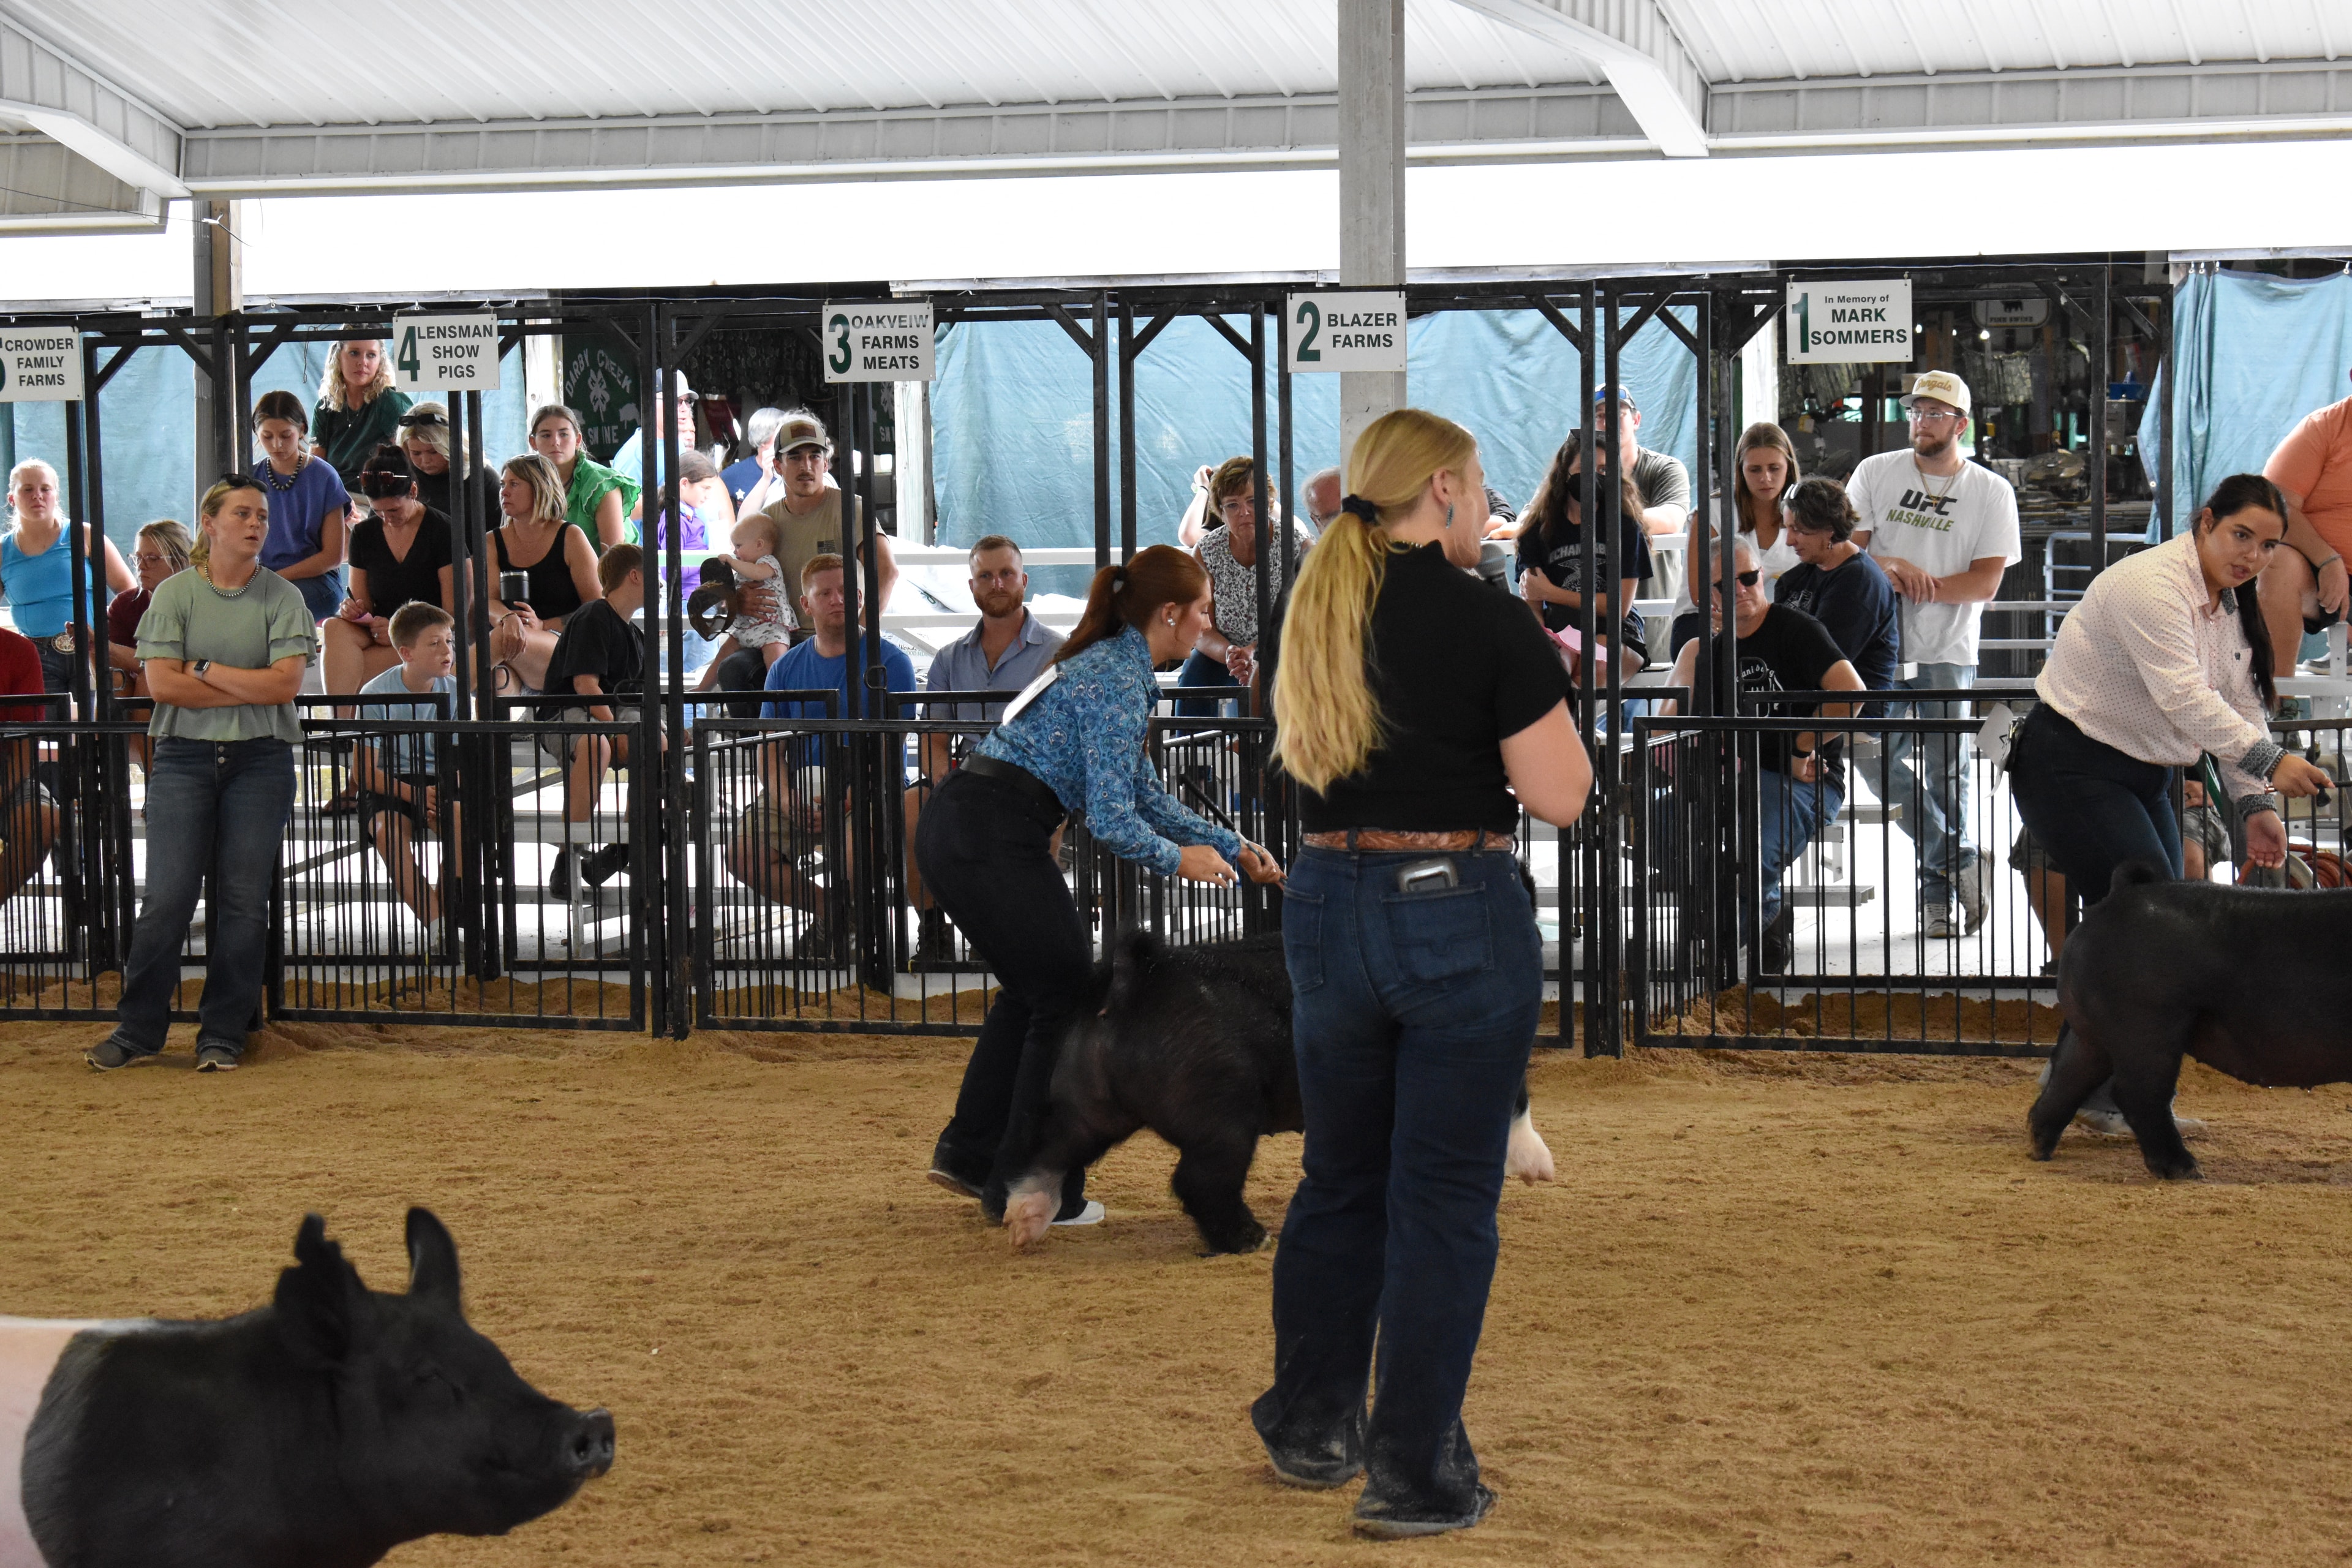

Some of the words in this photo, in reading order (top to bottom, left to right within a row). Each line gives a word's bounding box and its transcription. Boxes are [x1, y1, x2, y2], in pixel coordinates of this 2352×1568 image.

[1838, 295, 1876, 304] Memory
[851, 314, 929, 329] OAKVEIW
[1328, 313, 1397, 326] BLAZER
[1792, 293, 1809, 353] 1
[1831, 308, 1887, 323] MARK
[418, 324, 493, 339] LENSMAN
[1296, 301, 1321, 361] 2
[1811, 329, 1907, 345] SOMMERS
[5, 338, 74, 352] CROWDER
[828, 314, 852, 374] 3
[862, 335, 919, 349] FARMS
[1333, 334, 1393, 348] FARMS
[398, 326, 420, 382] 4
[432, 345, 480, 359] SHOW
[17, 356, 64, 369] FAMILY
[863, 355, 919, 369] MEATS
[439, 364, 475, 378] PIGS
[565, 348, 590, 398] DARBY
[597, 349, 632, 394] CREEK
[19, 374, 65, 386] FARMS
[587, 425, 619, 445] SWINE
[1899, 489, 1958, 516] UFC
[1886, 509, 1954, 532] NASHVILLE
